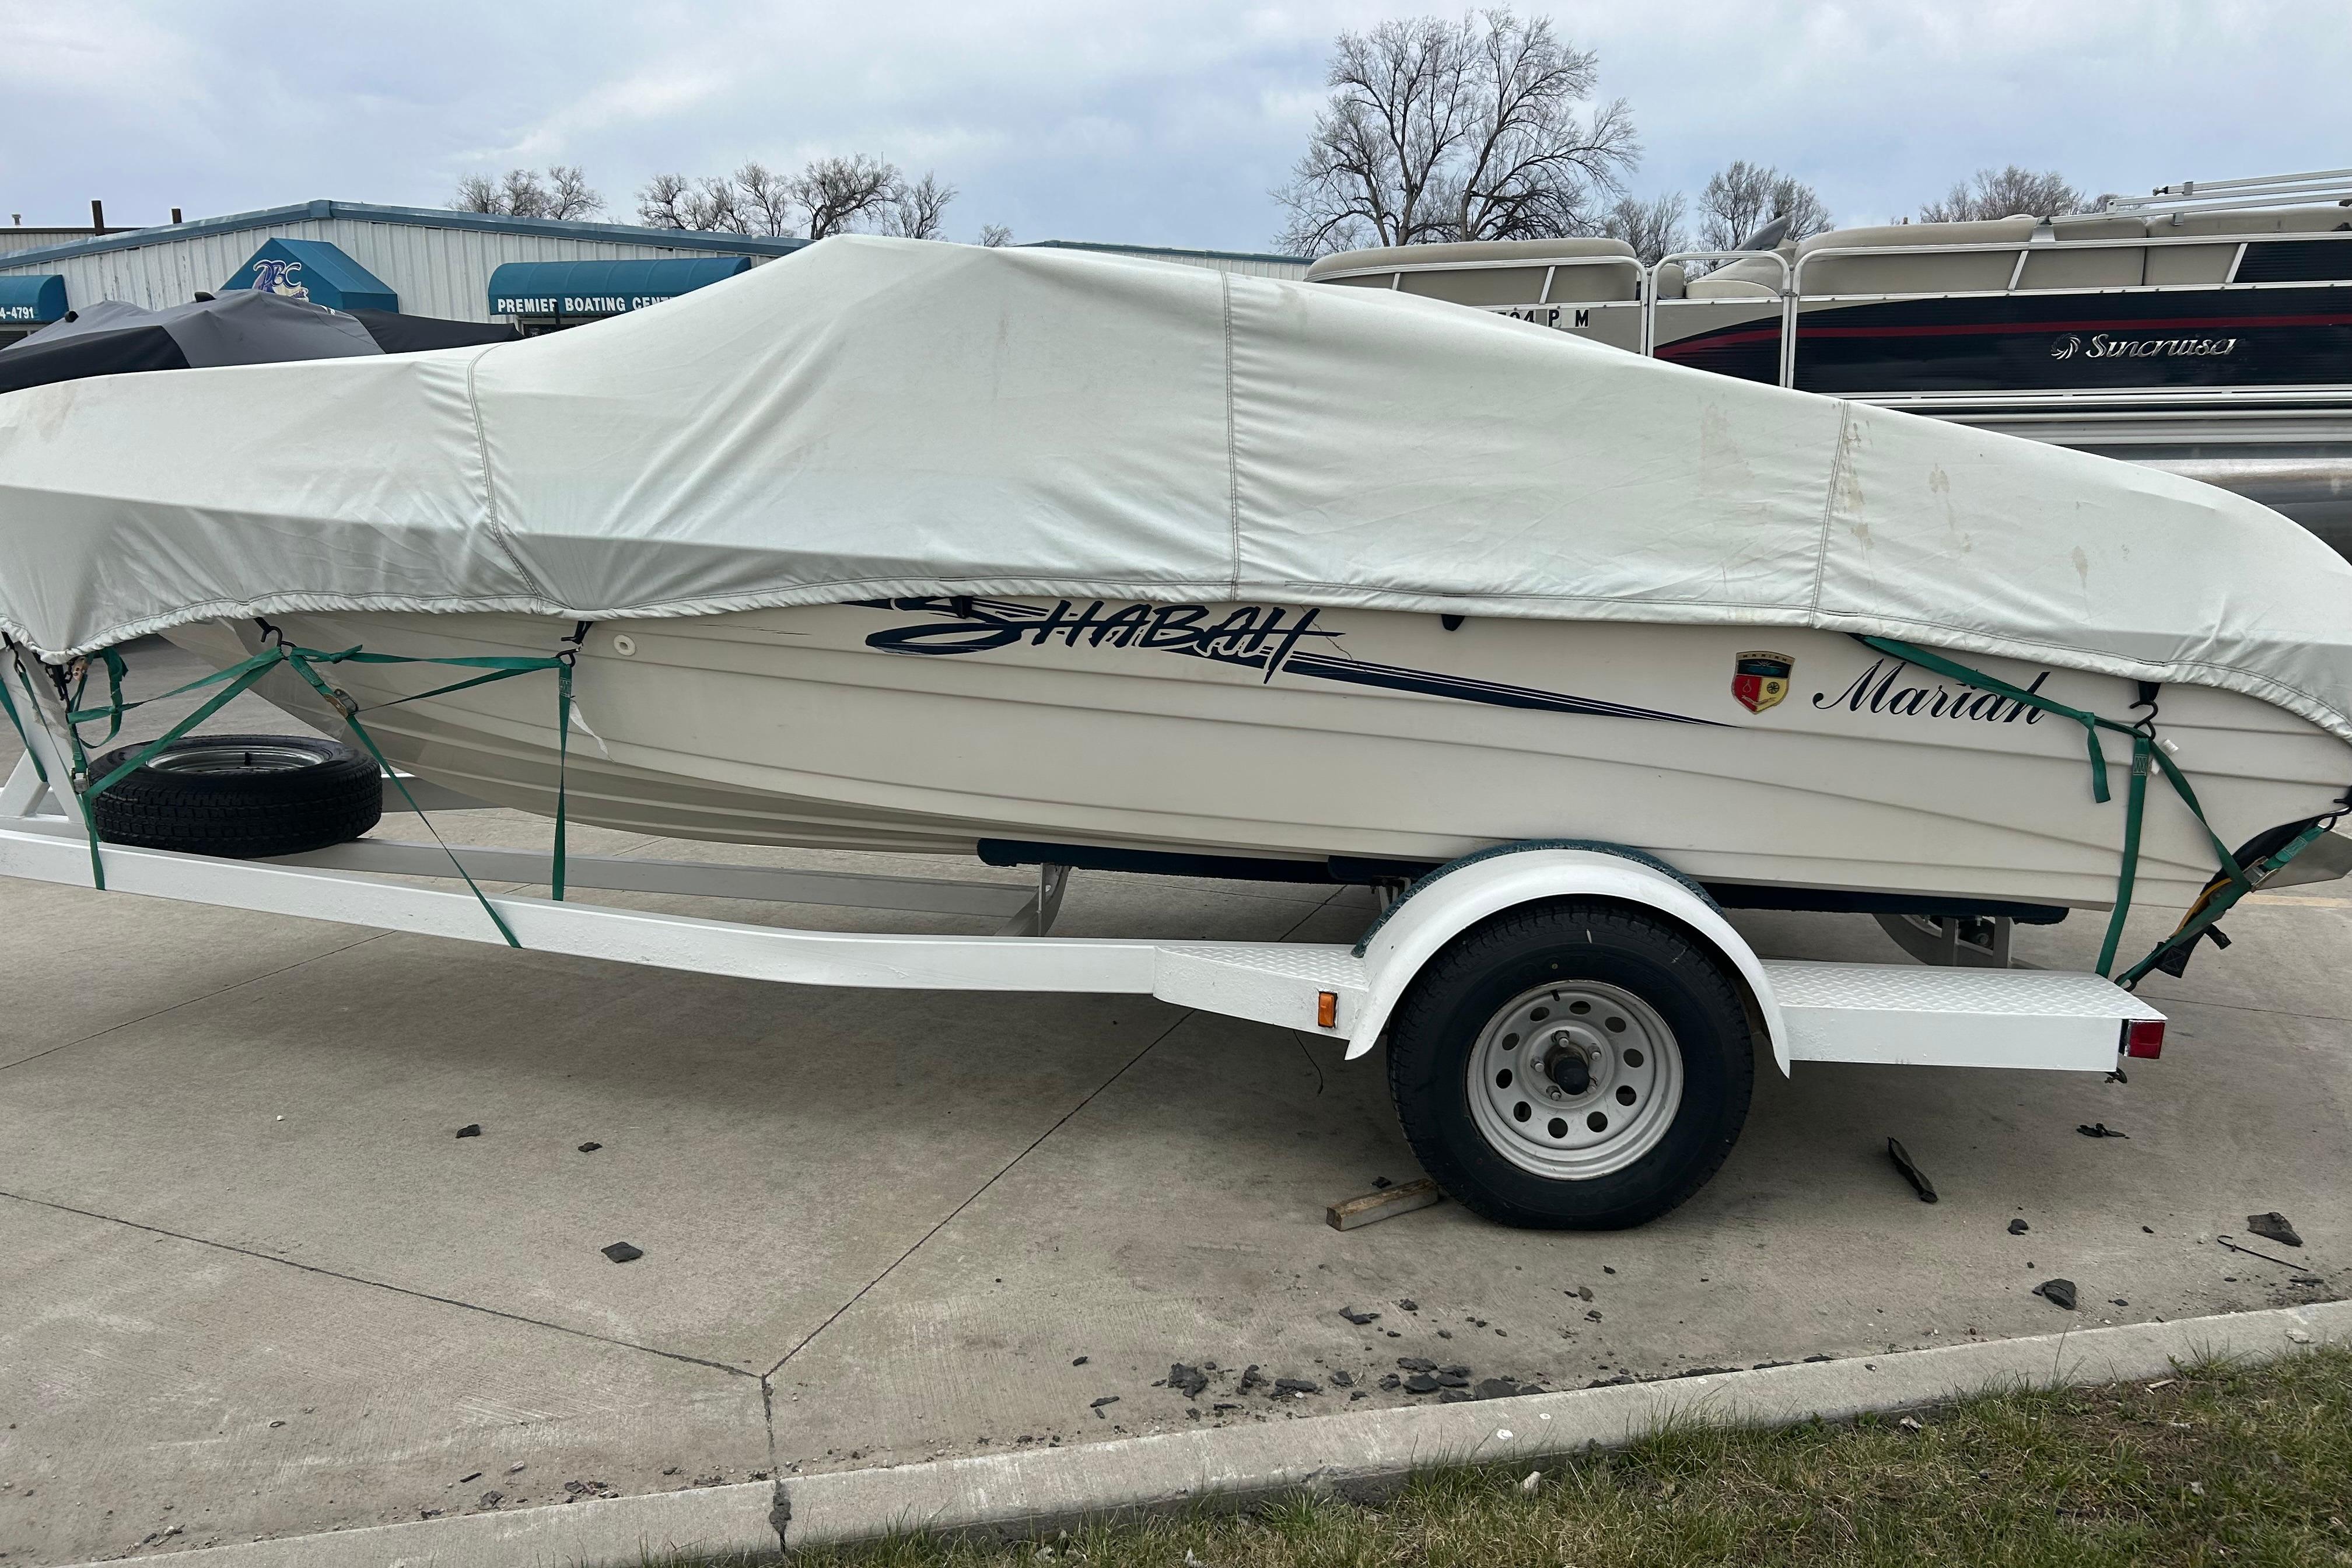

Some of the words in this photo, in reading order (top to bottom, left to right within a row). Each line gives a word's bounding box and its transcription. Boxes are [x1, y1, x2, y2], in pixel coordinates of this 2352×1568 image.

[0, 306, 34, 319] 4-4791
[564, 297, 626, 312] BOATING
[2085, 333, 2245, 358] Suncruiser
[865, 595, 1346, 684] SHABAH
[1812, 657, 2051, 725] Mariah
